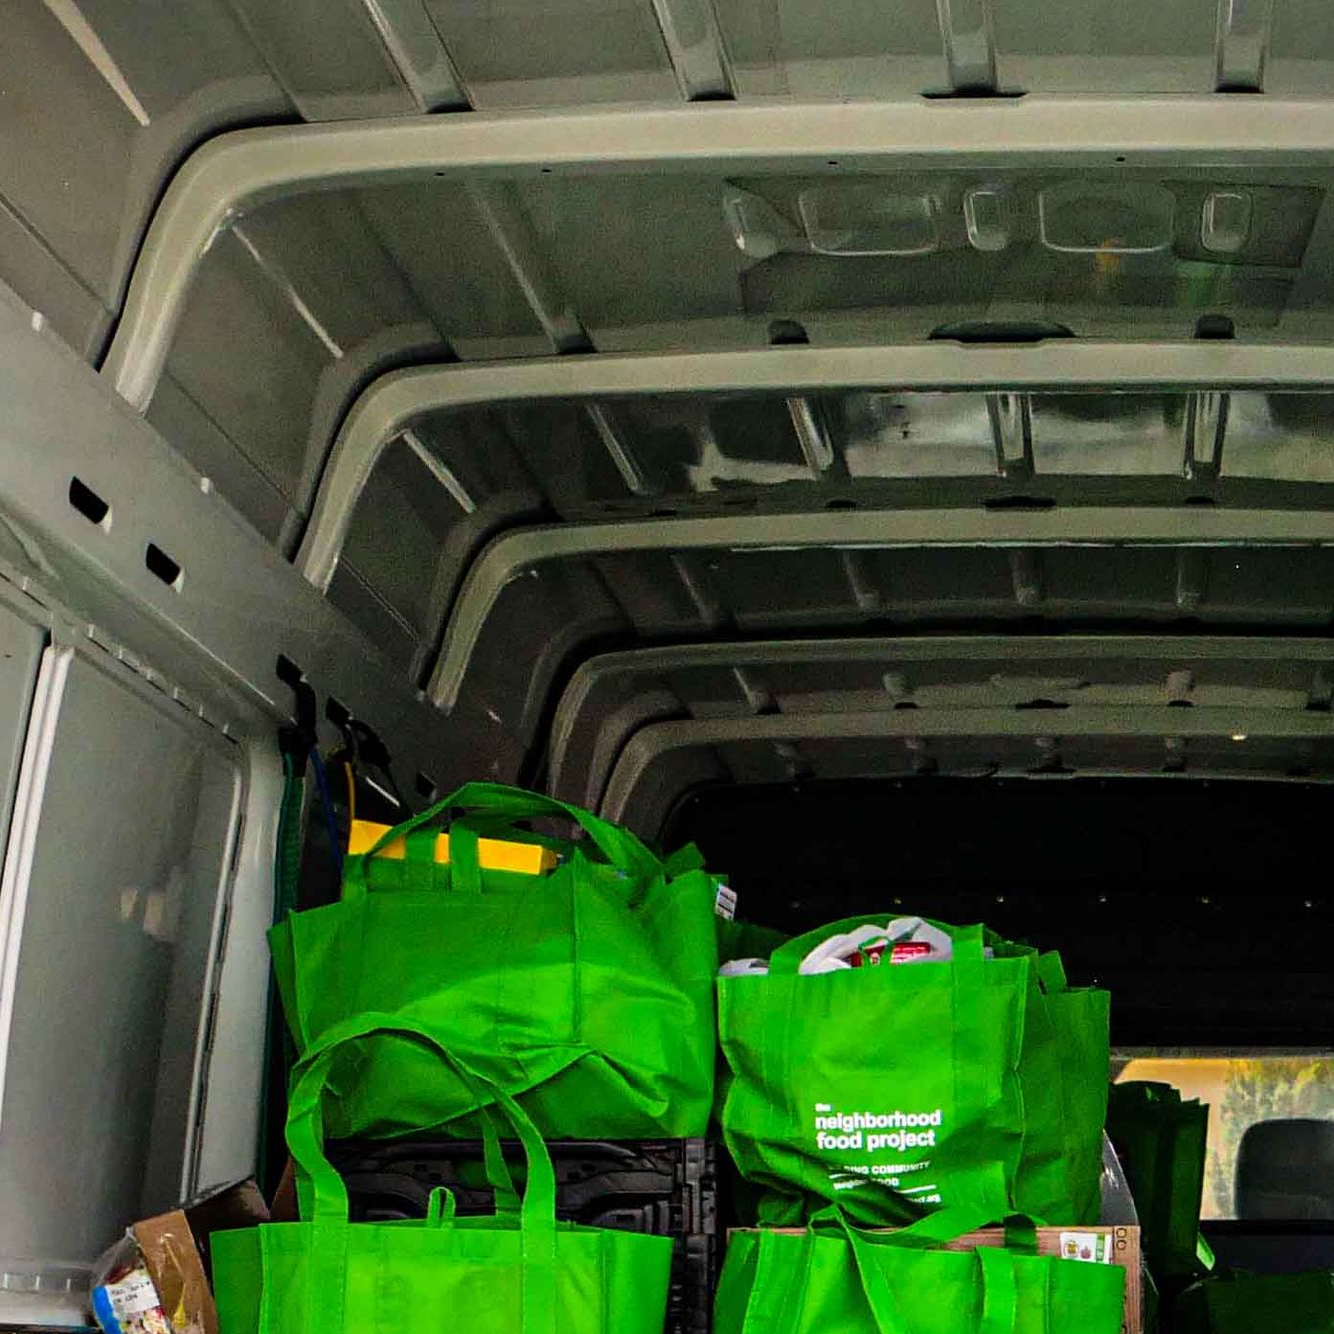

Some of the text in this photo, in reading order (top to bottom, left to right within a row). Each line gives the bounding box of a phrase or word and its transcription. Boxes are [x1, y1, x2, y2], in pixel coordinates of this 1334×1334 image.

[815, 1109, 942, 1132] neighborhood
[817, 1129, 936, 1152] food project
